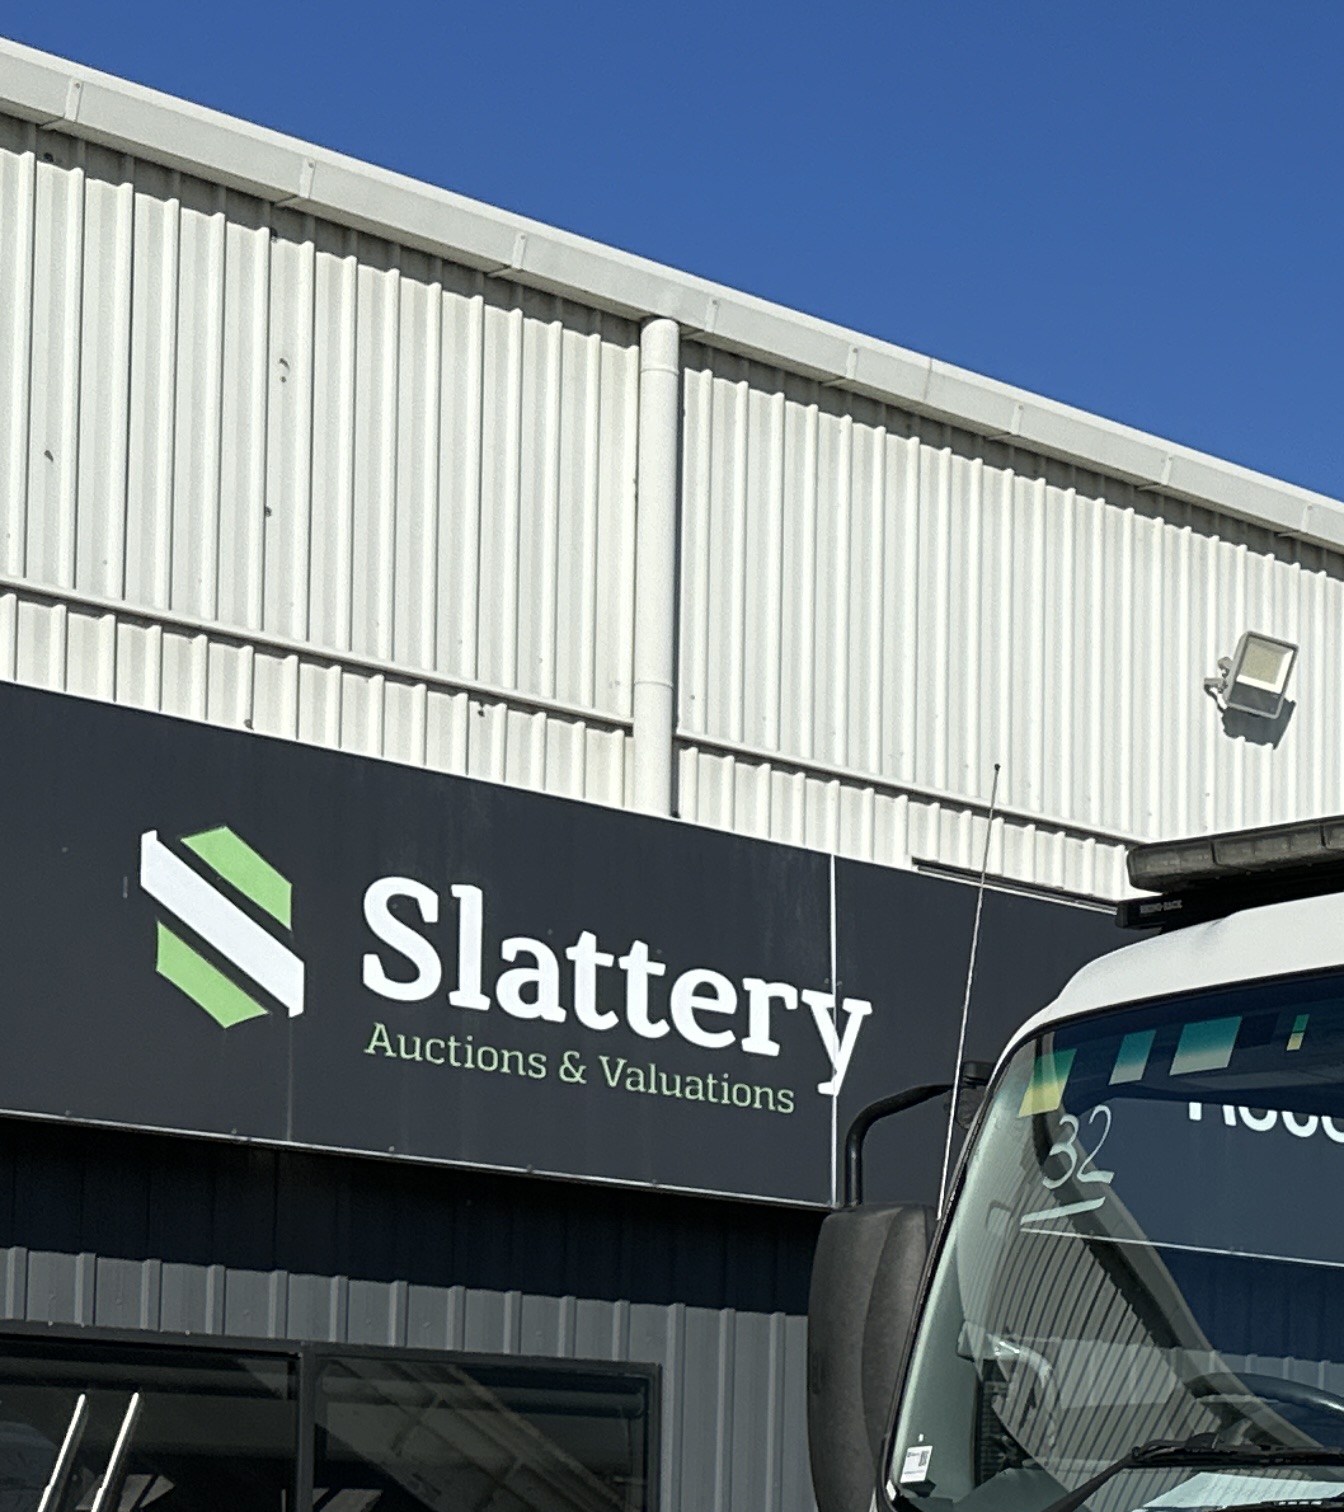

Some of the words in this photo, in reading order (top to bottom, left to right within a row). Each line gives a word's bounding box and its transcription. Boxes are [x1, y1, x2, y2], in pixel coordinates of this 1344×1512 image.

[362, 876, 873, 1096] Slattery
[364, 1022, 547, 1079] Auctions
[558, 1051, 588, 1085] &
[599, 1055, 796, 1114] Valuations
